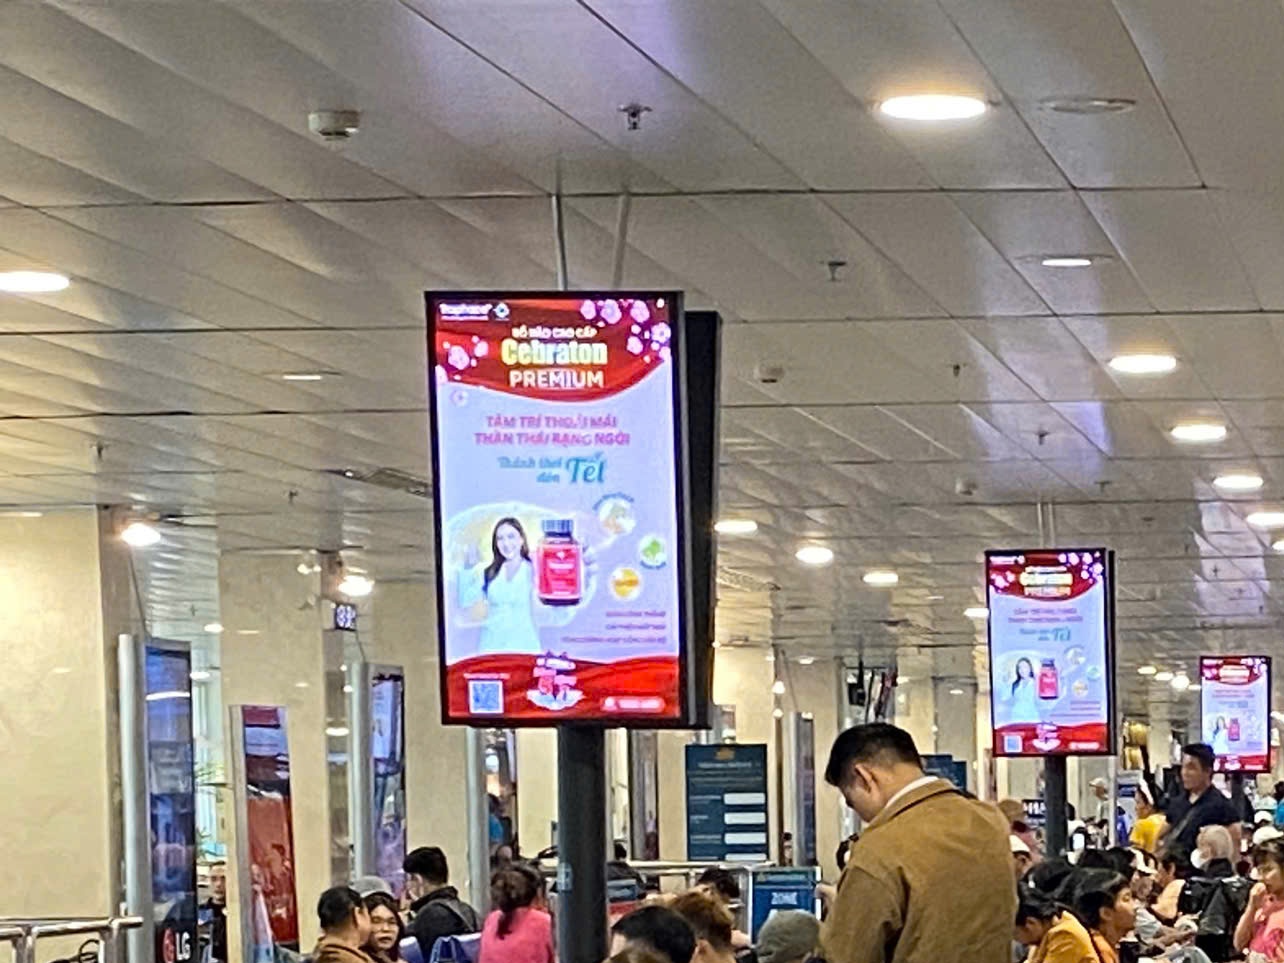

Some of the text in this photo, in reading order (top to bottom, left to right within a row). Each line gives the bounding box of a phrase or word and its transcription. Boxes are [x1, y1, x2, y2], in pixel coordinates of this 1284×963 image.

[501, 338, 608, 365] Cebraton
[509, 370, 604, 388] PREMIUM
[566, 451, 605, 484] Tết
[175, 931, 191, 961] LG
